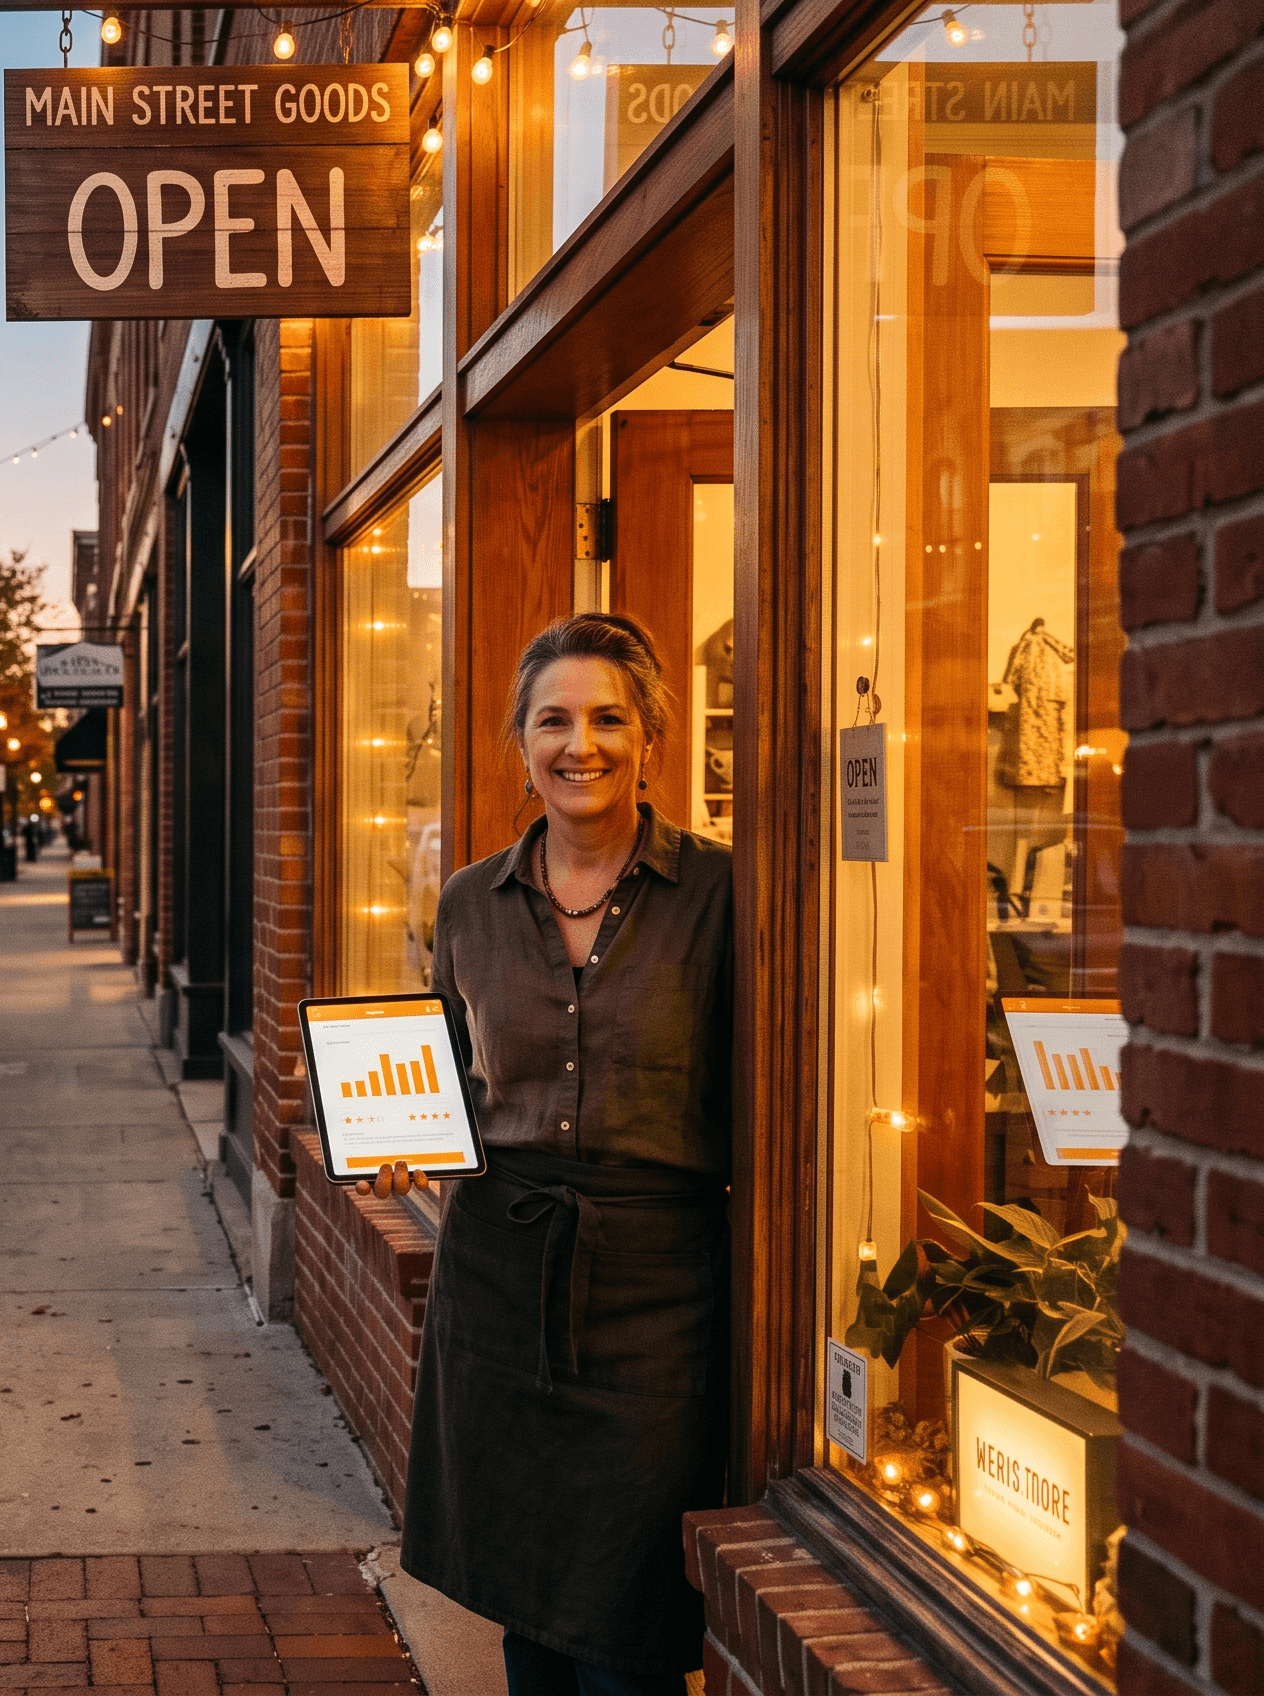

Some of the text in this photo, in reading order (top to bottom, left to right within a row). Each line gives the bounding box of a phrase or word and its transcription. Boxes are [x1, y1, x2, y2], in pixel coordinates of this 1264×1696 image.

[25, 82, 391, 126] MAIN STREET GOODS
[67, 167, 346, 291] OPEN
[846, 757, 878, 788] OPEN
